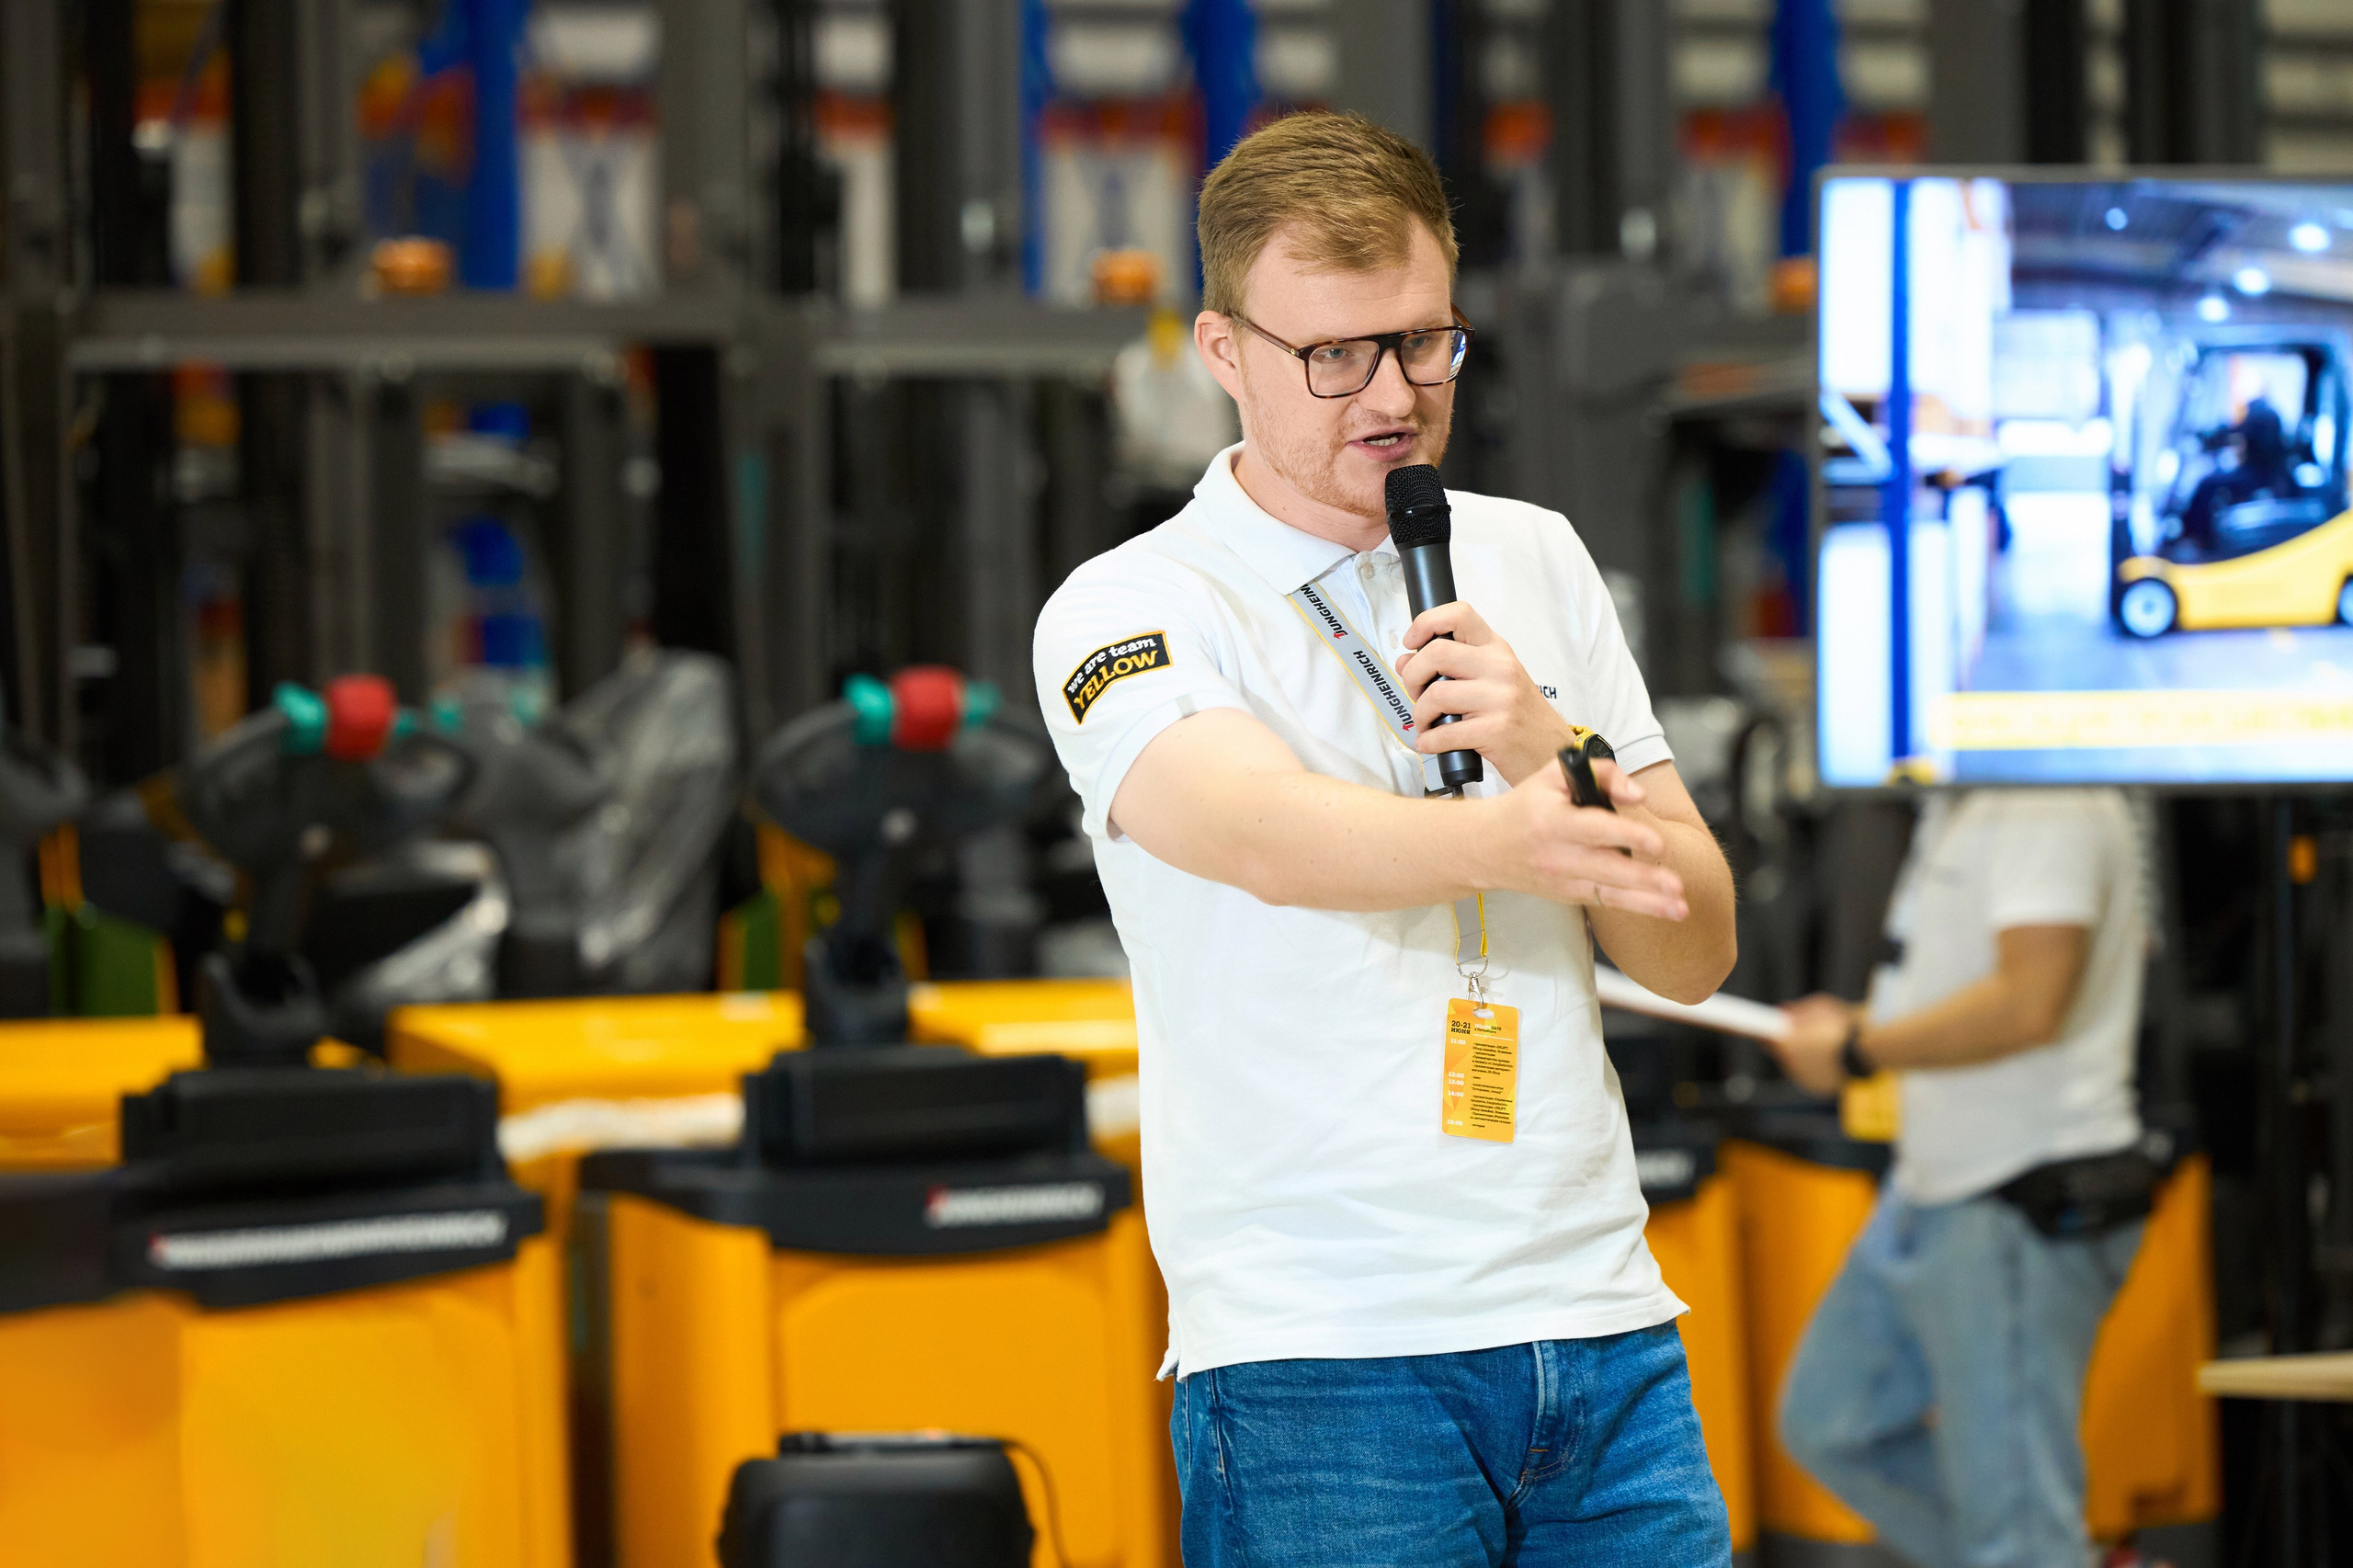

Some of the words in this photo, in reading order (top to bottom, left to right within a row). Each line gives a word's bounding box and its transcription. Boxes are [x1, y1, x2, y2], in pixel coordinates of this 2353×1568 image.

[1067, 672, 1085, 694] we
[1084, 651, 1108, 675] are
[1108, 638, 1157, 657] team
[1074, 650, 1158, 710] YELLOW
[1450, 1027, 1471, 1035] ИЮНЯ
[1451, 1020, 1471, 1028] 20-21
